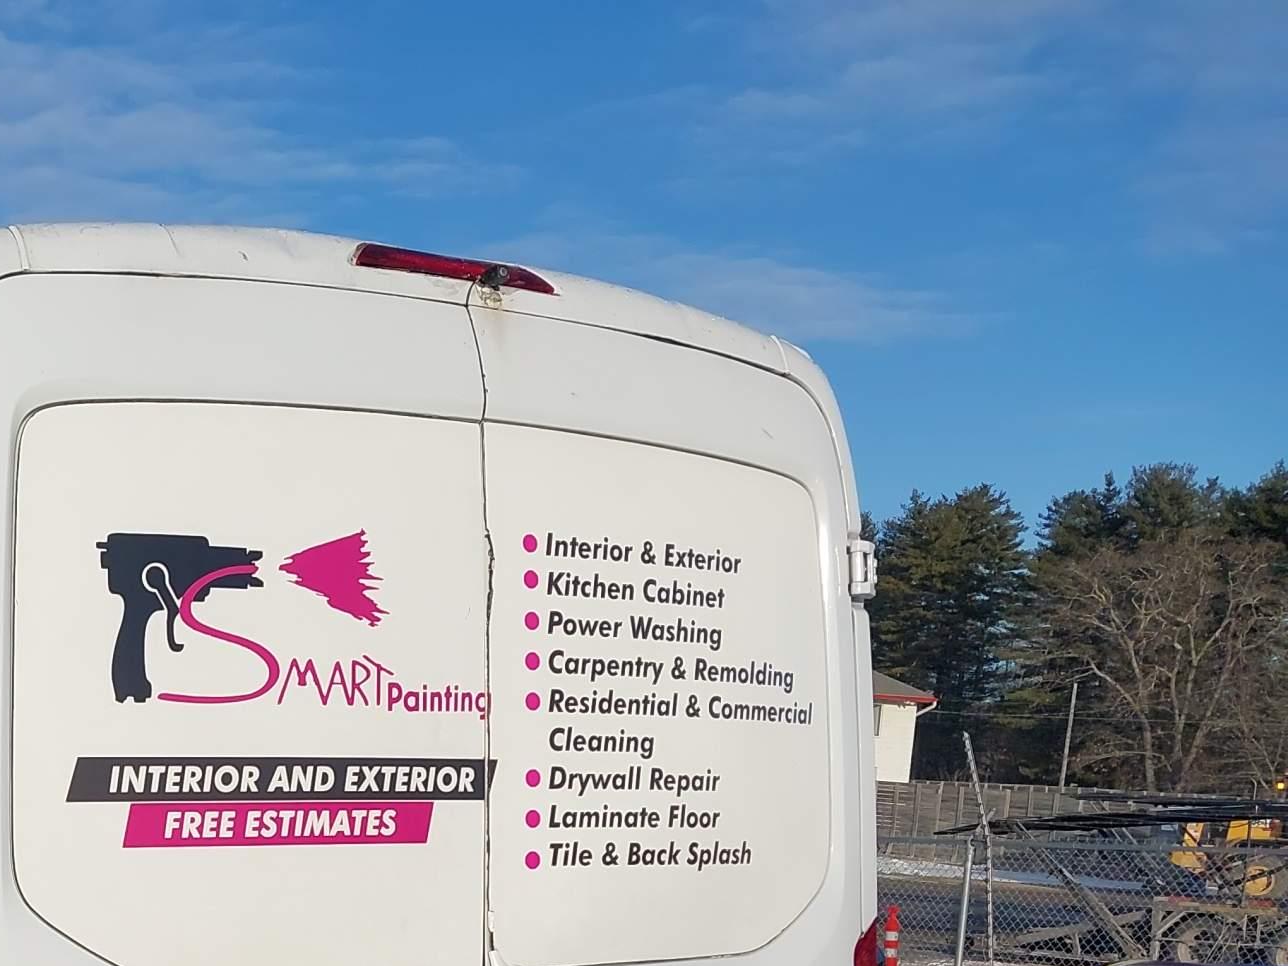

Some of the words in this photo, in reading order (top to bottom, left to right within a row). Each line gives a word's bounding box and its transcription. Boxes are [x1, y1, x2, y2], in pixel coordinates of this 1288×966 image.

[545, 532, 633, 563] Interior
[640, 541, 657, 565] &
[664, 544, 741, 574] Exterior
[546, 571, 635, 600] Kitchen
[642, 579, 725, 608] Cabinet
[547, 610, 623, 638] Power
[630, 615, 722, 651] Washing
[548, 650, 664, 685] Carpentry
[671, 656, 686, 680] &
[694, 657, 794, 693] Remolding
[387, 683, 492, 720] Painting
[548, 689, 678, 717] Residential
[685, 694, 701, 718] &
[708, 695, 813, 725] Commercial
[549, 727, 655, 759] Cleaning
[109, 765, 258, 794] INTERIOR
[267, 766, 334, 793] AND
[344, 766, 475, 793] EXTERIOR
[548, 766, 641, 797] Drywall
[649, 768, 721, 796] Repair
[164, 810, 234, 839] FREE
[245, 808, 397, 837] ESTIMATES
[548, 804, 661, 828] Laminate
[667, 804, 721, 828] Floor
[549, 842, 593, 866] Tile
[601, 843, 619, 866] &
[627, 842, 680, 866] Back
[686, 841, 752, 871] Splash
